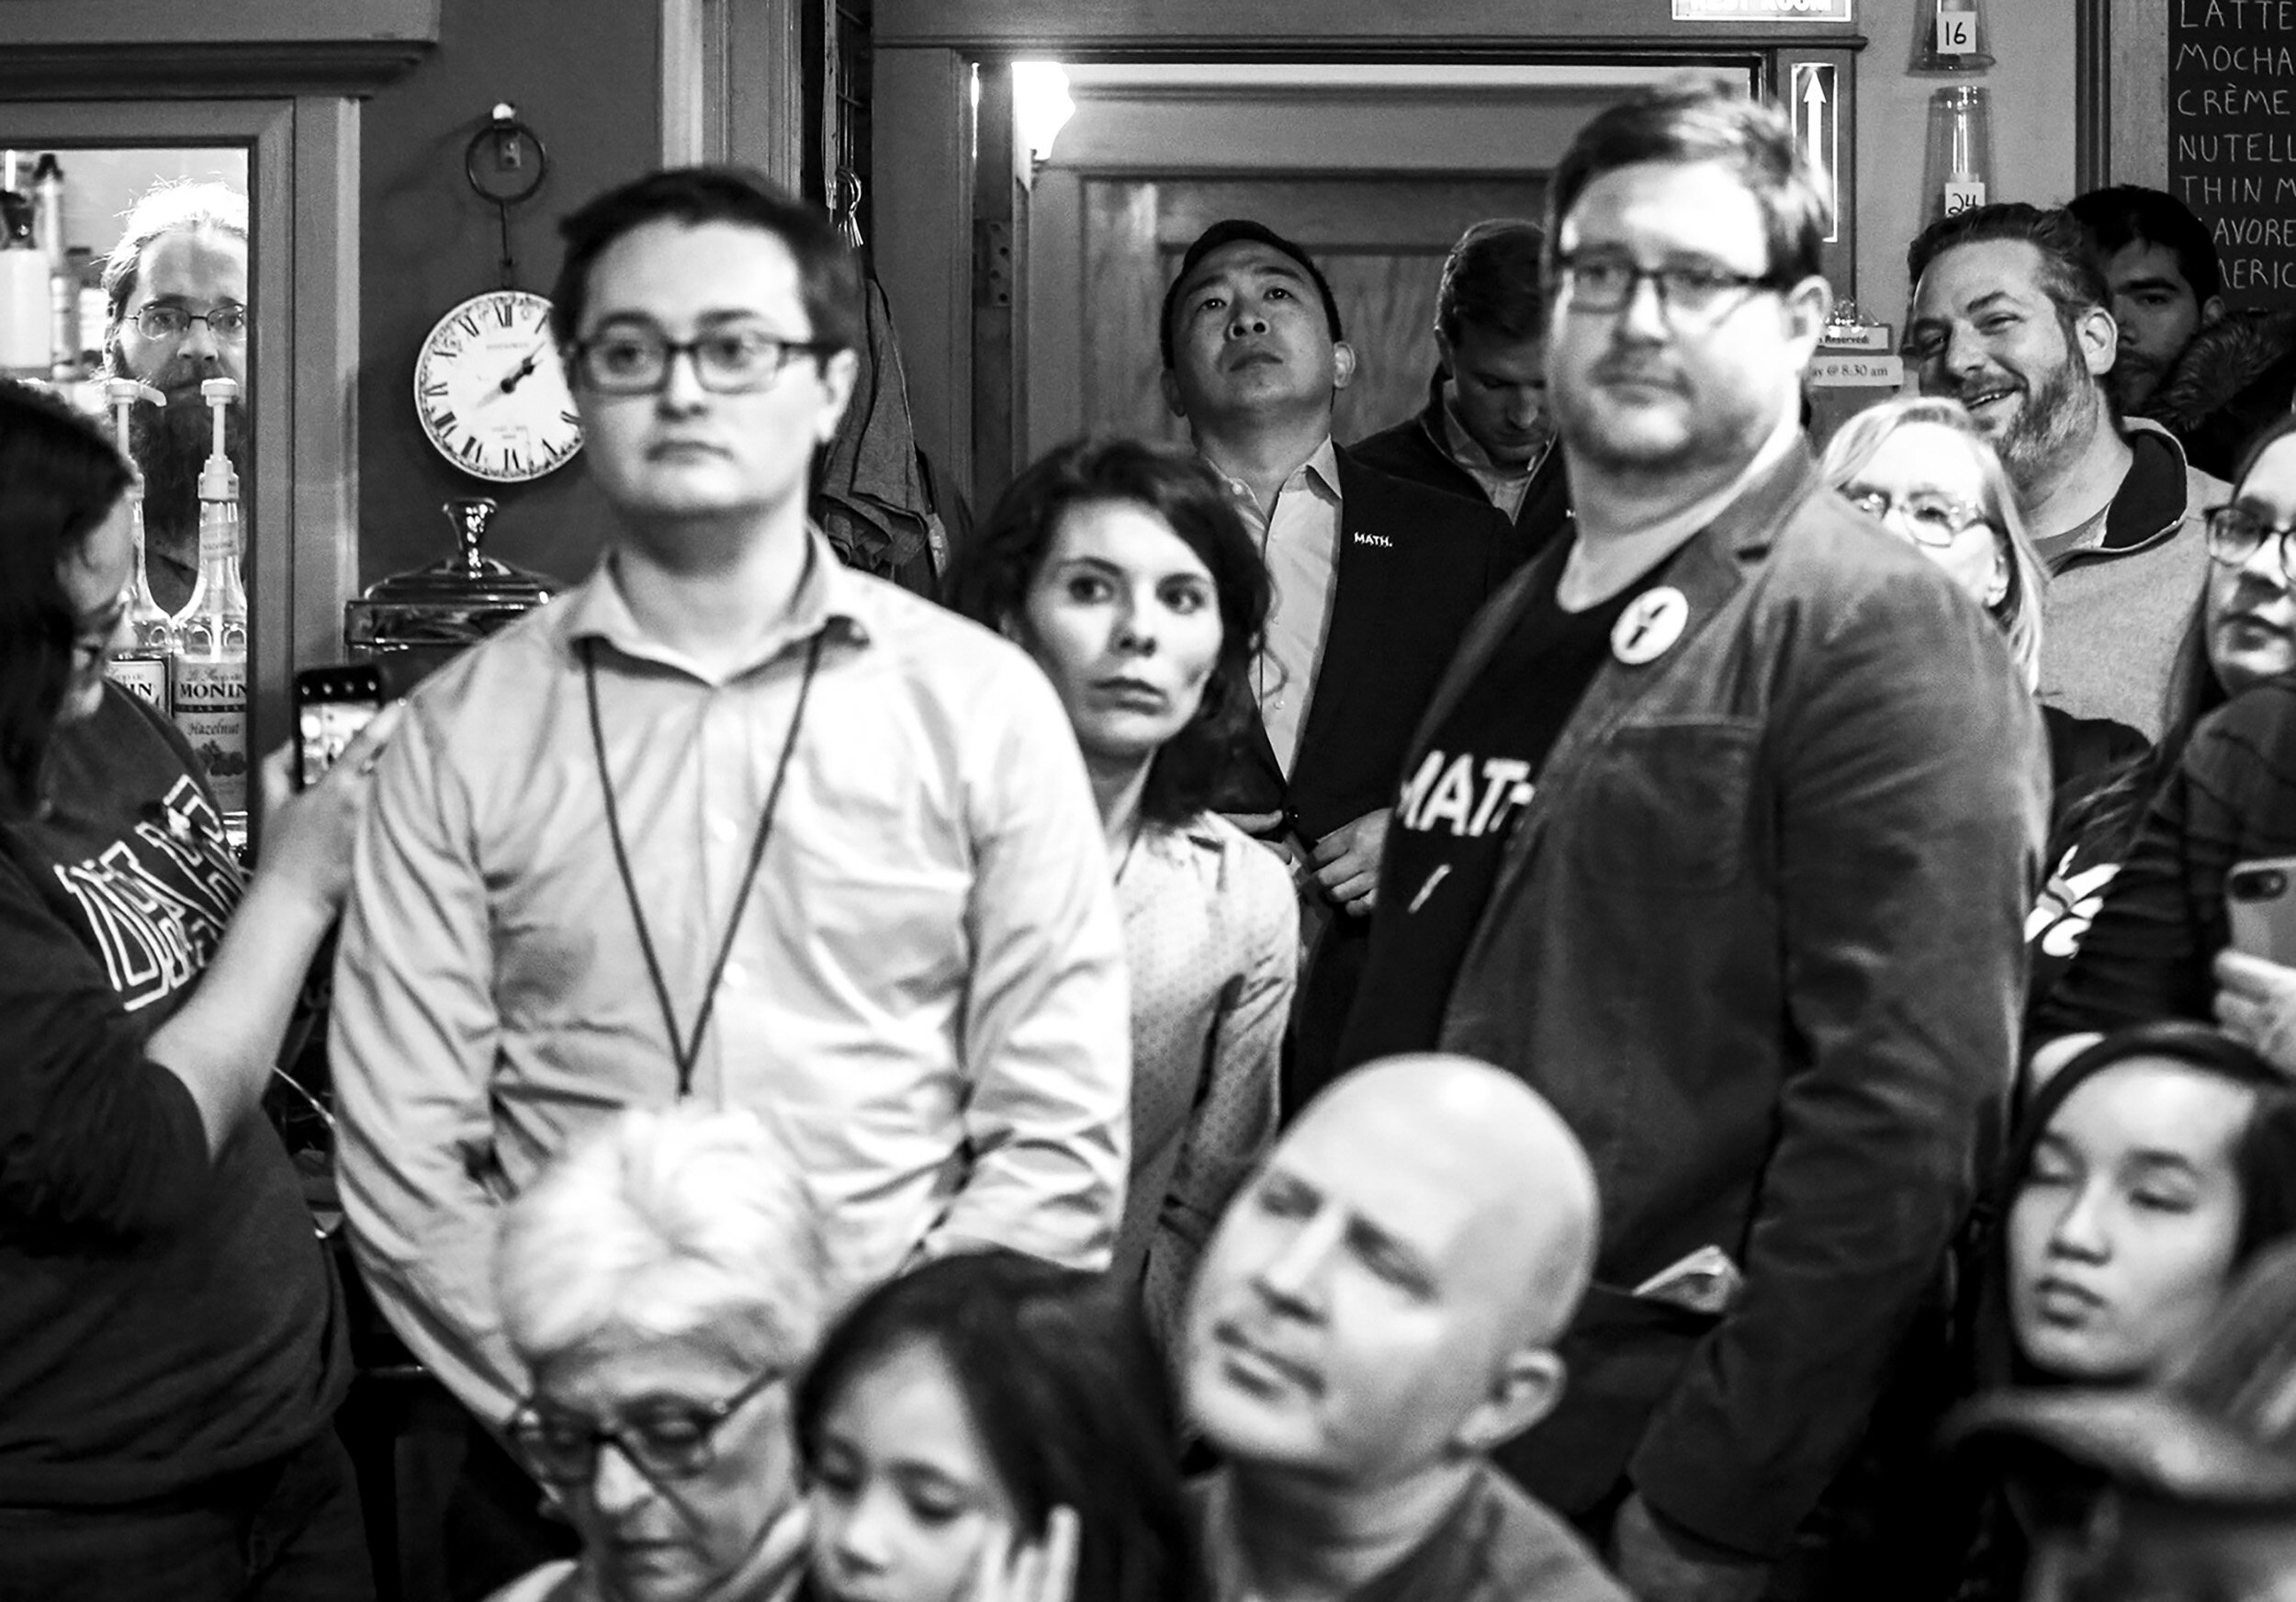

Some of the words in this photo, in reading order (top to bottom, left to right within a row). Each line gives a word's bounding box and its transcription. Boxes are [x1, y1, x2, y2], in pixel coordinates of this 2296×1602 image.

[2181, 0, 2293, 29] LATTE
[1946, 21, 1966, 46] 16
[2176, 43, 2295, 75] MOCHA
[2178, 83, 2290, 116] CRÈME
[2179, 133, 2296, 162] NUTELL
[2180, 175, 2262, 204] THIN
[1948, 193, 1976, 216] 24
[2212, 217, 2296, 247] AVORE
[1827, 365, 1839, 376] @
[1871, 368, 1888, 377] am
[1354, 531, 1393, 548] MATH.
